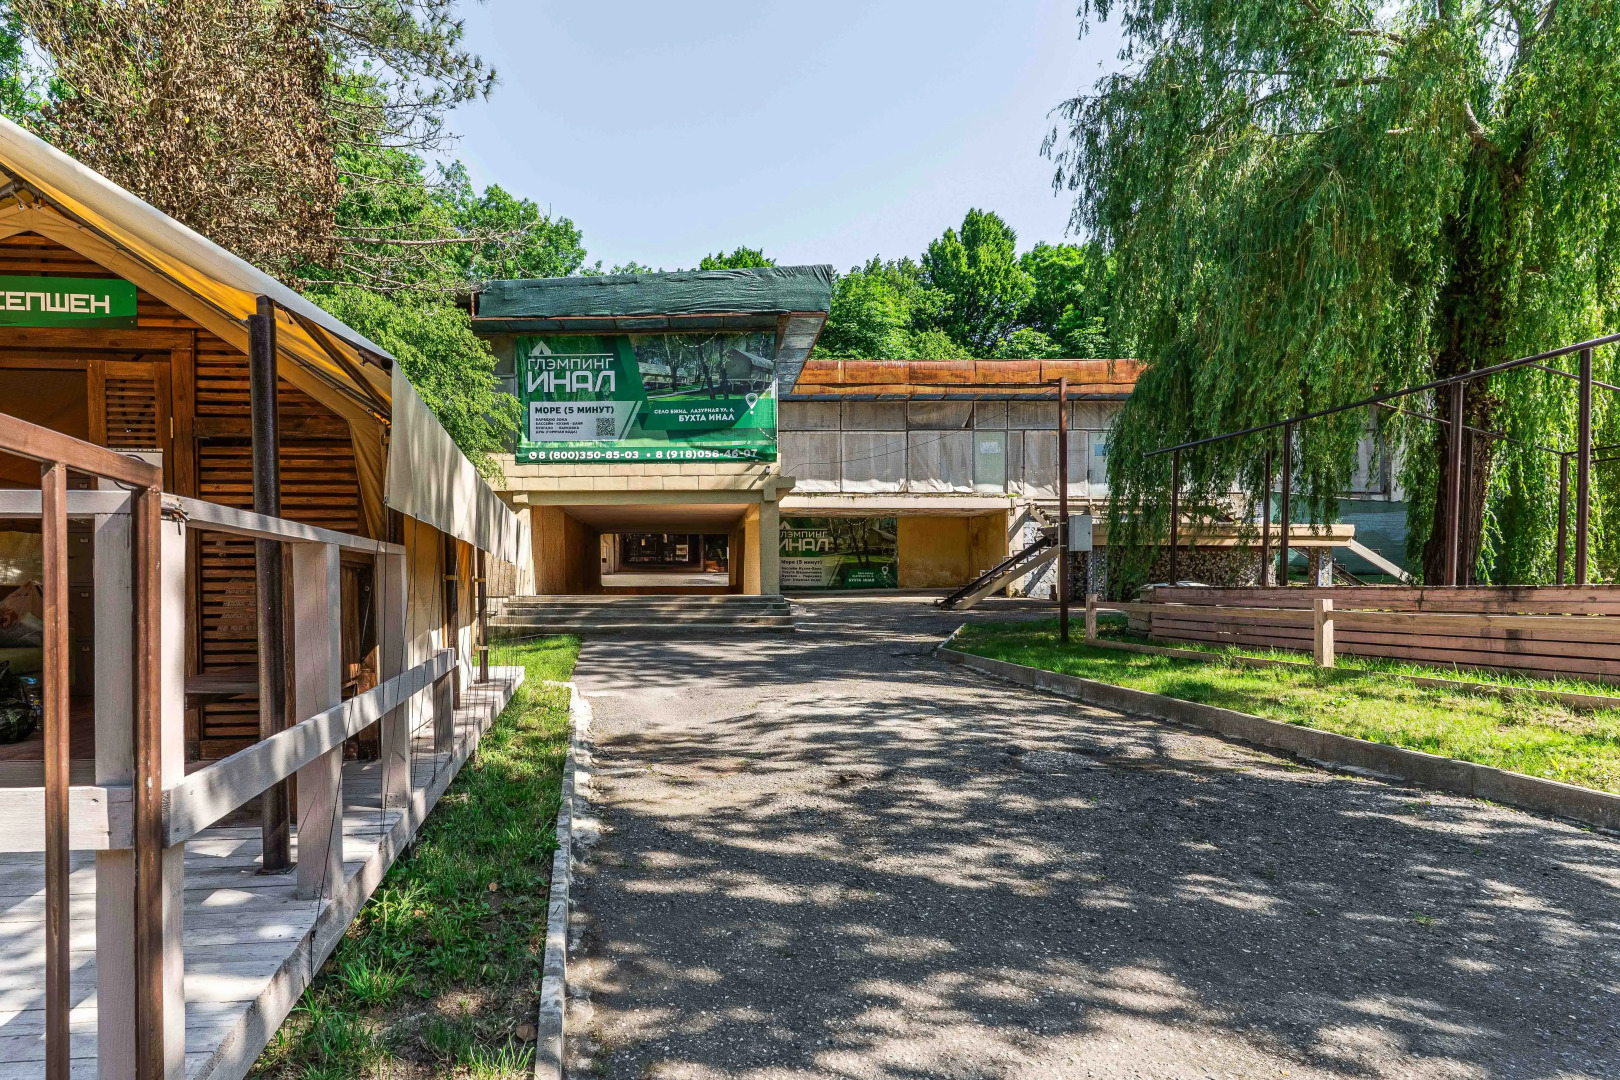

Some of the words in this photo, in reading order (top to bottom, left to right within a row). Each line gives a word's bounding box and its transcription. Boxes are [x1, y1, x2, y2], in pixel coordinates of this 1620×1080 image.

[0, 290, 110, 314] ЕПШЕН
[527, 358, 614, 370] ГЛЭМПИНГ
[527, 370, 616, 393] ИНАЛ
[534, 406, 562, 414] МОРЕ
[564, 406, 575, 415] (5
[577, 405, 615, 415] МИНУТ)
[678, 414, 707, 422] БУХТА
[708, 413, 735, 421] ИНАЛ
[538, 451, 546, 460] 8
[549, 450, 639, 460] (800)350-85-03
[655, 450, 663, 459] 8
[779, 530, 828, 539] ЛЭМПИНГ
